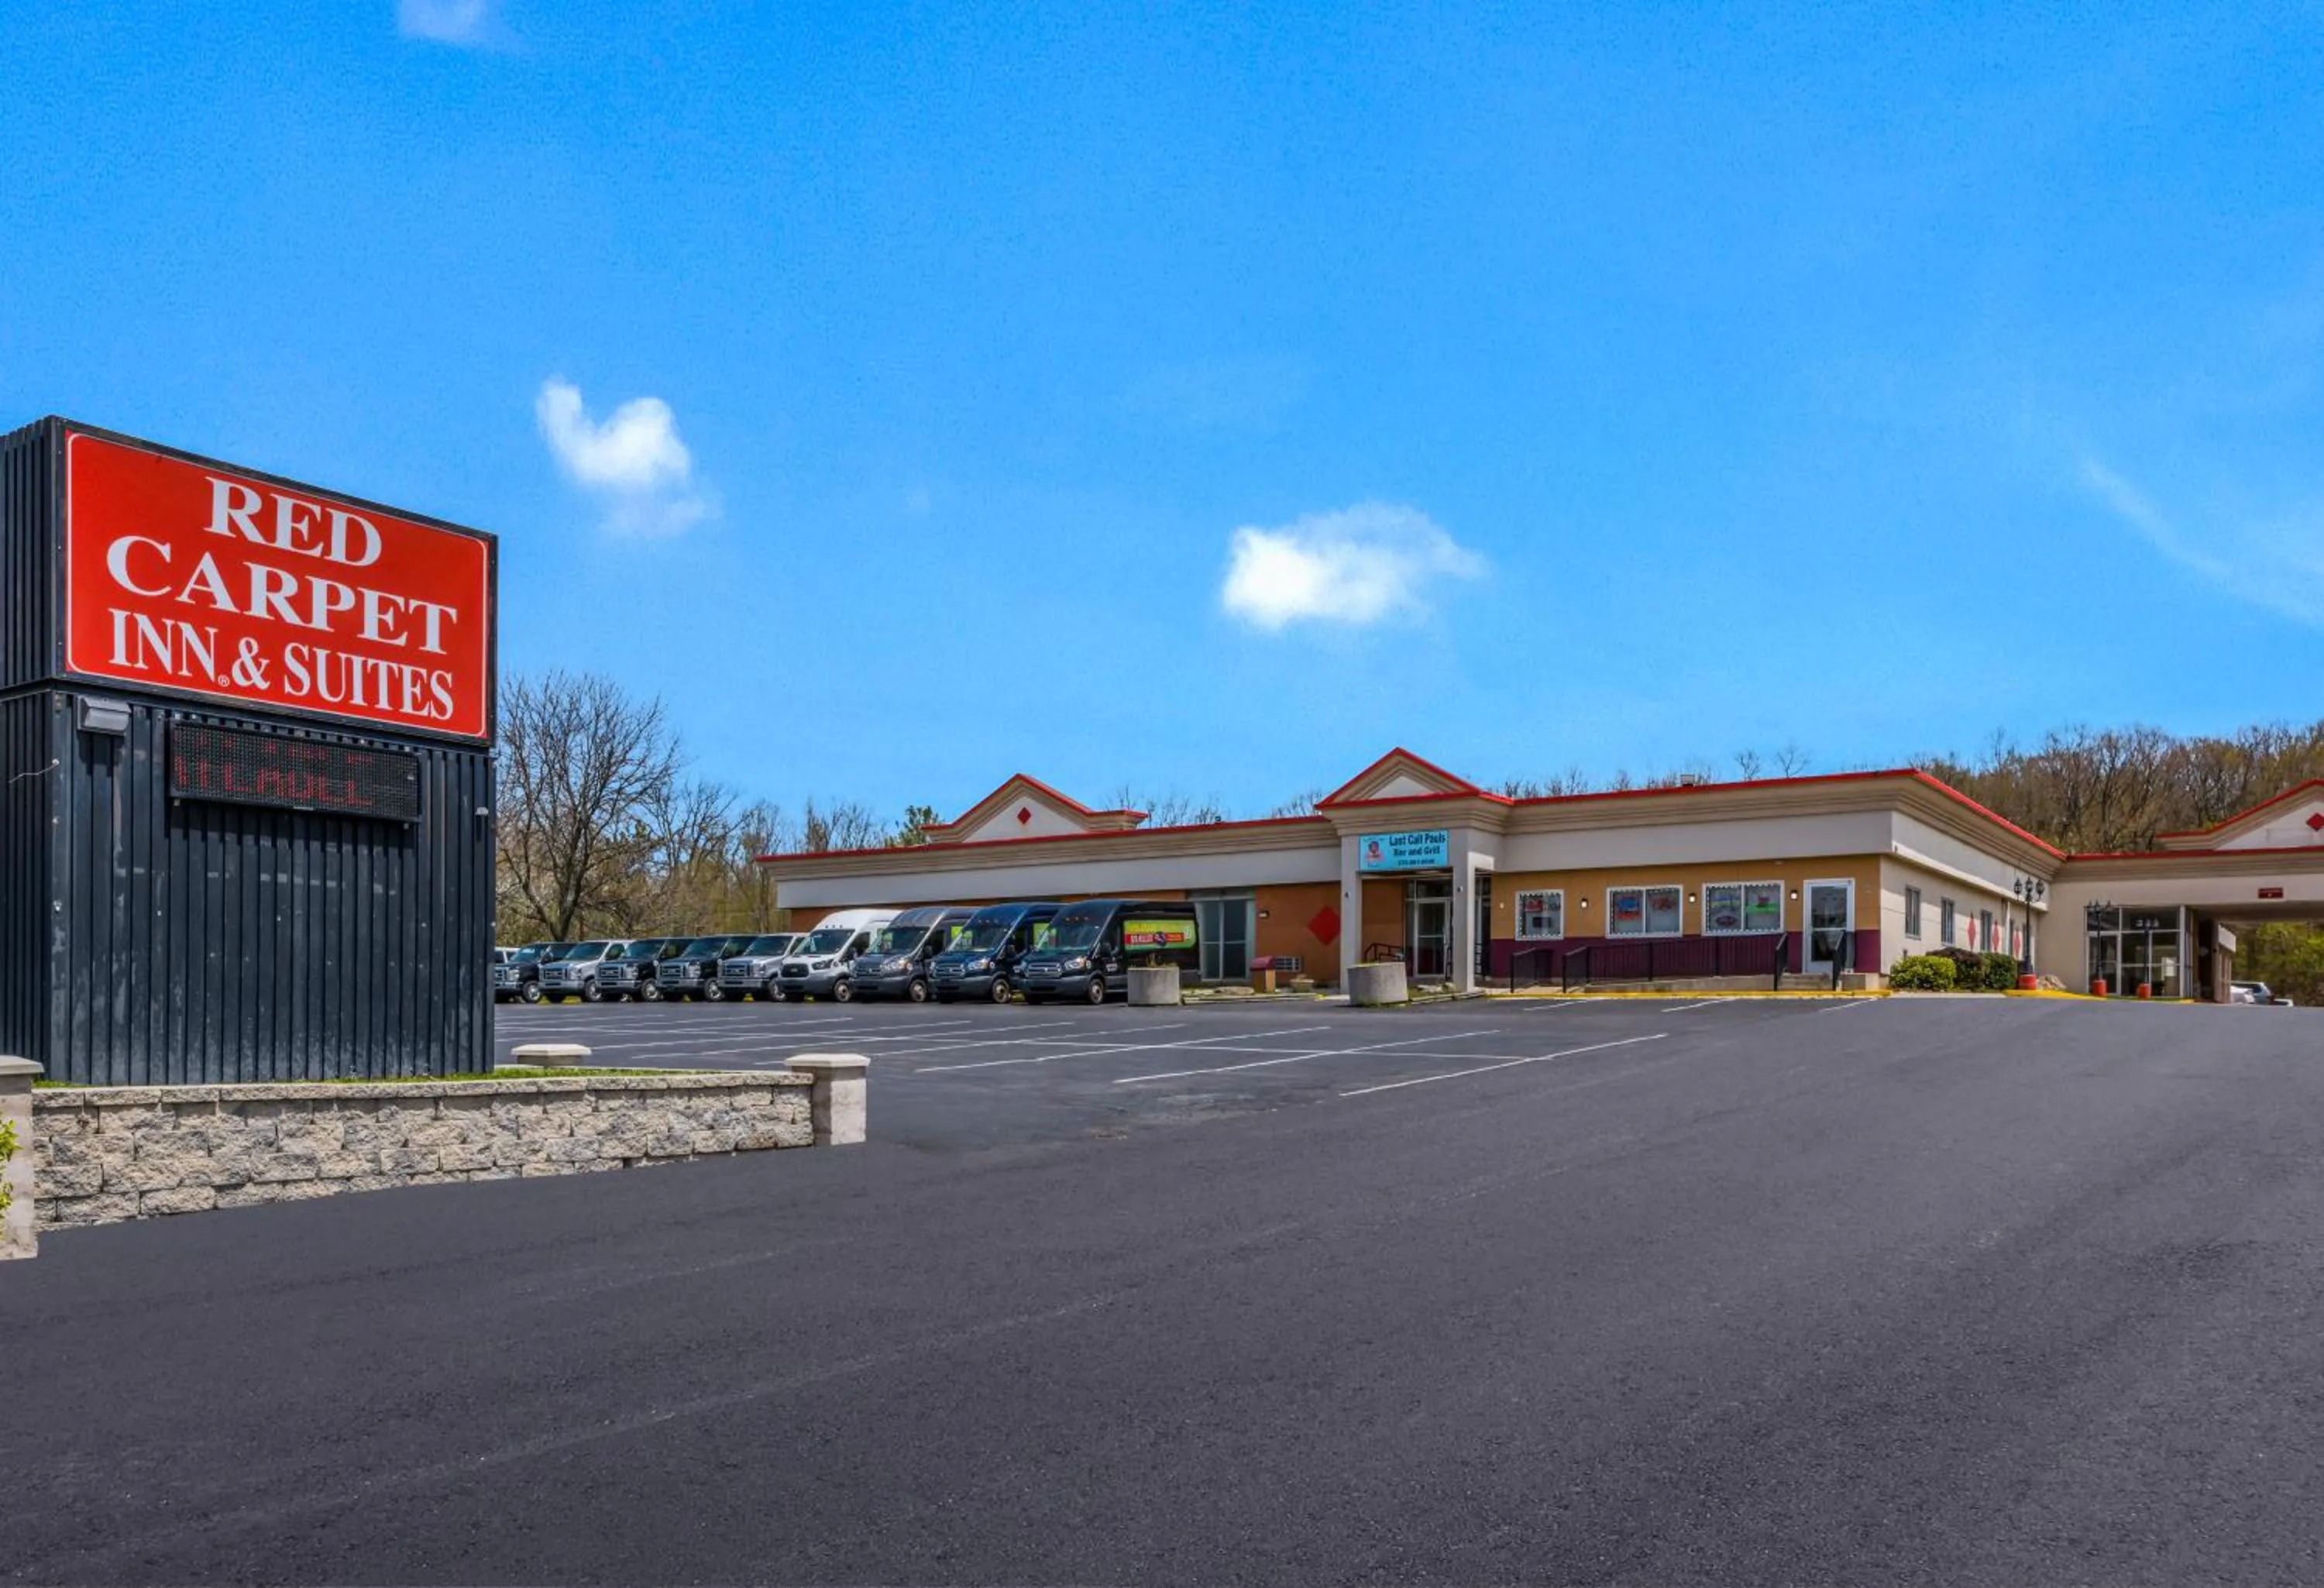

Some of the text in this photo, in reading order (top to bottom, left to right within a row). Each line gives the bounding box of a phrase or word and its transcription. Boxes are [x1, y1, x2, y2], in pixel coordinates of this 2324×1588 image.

[205, 476, 383, 568] RED
[106, 535, 457, 655] CARPET
[232, 637, 270, 690] &
[284, 642, 453, 721] SUITES
[1389, 835, 1406, 847] Last
[1408, 834, 1423, 844] Call
[1408, 847, 1422, 856] and
[1424, 845, 1440, 854] Grill
